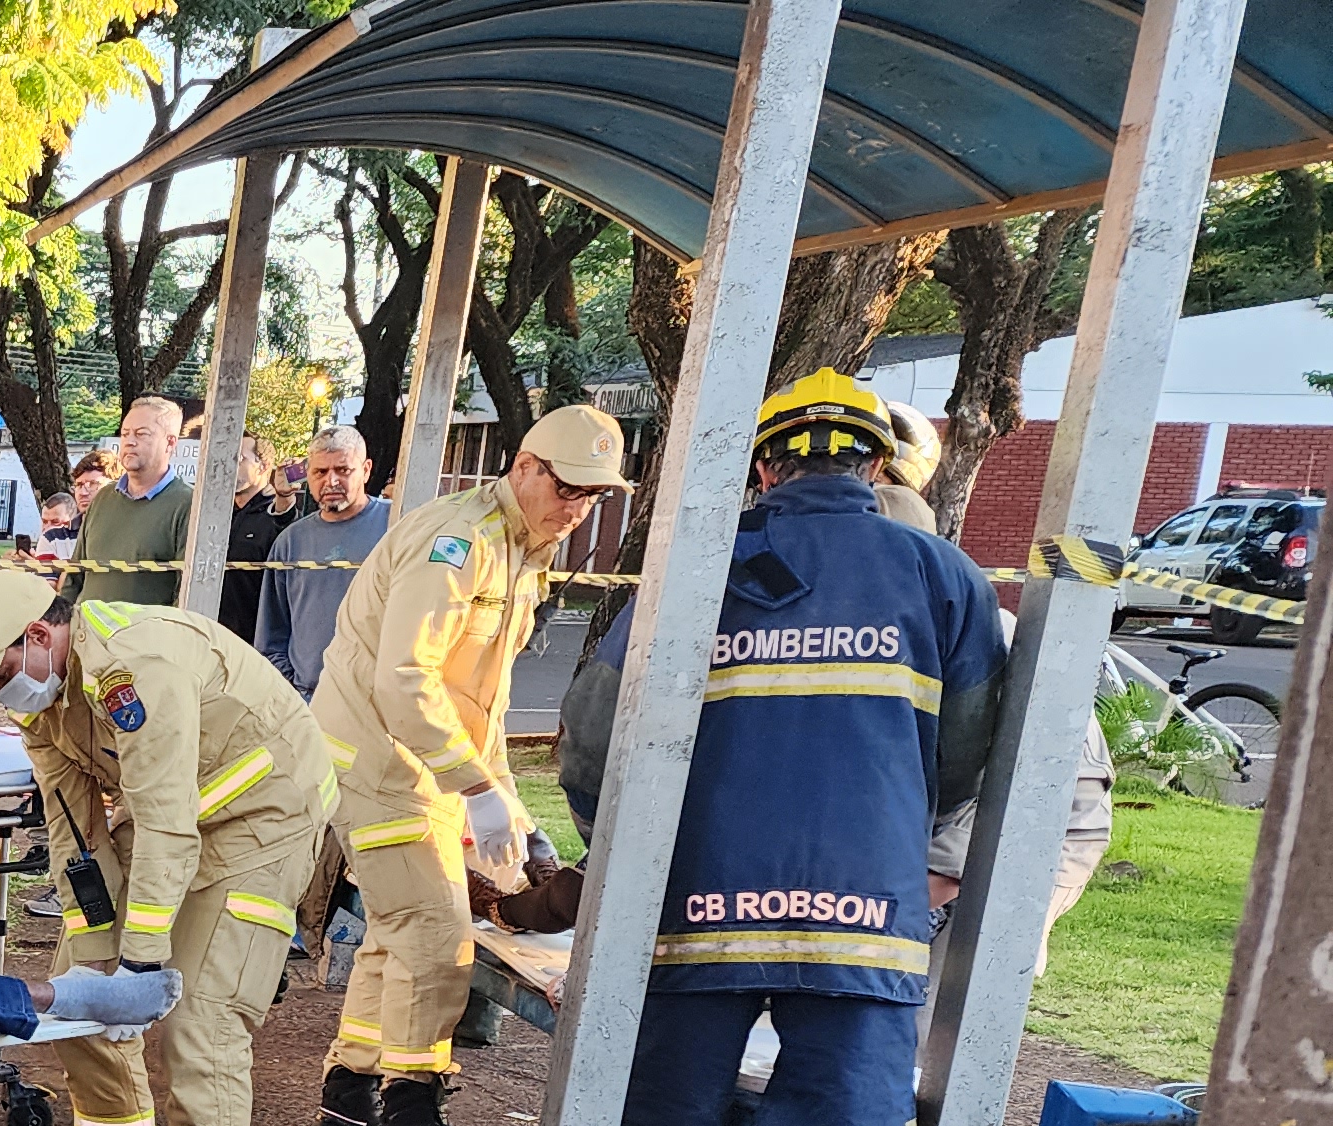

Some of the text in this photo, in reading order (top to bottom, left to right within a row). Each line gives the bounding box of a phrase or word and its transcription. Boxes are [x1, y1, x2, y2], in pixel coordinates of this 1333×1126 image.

[711, 625, 900, 664] BOMBEIROS
[686, 889, 888, 928] CB ROBSON
